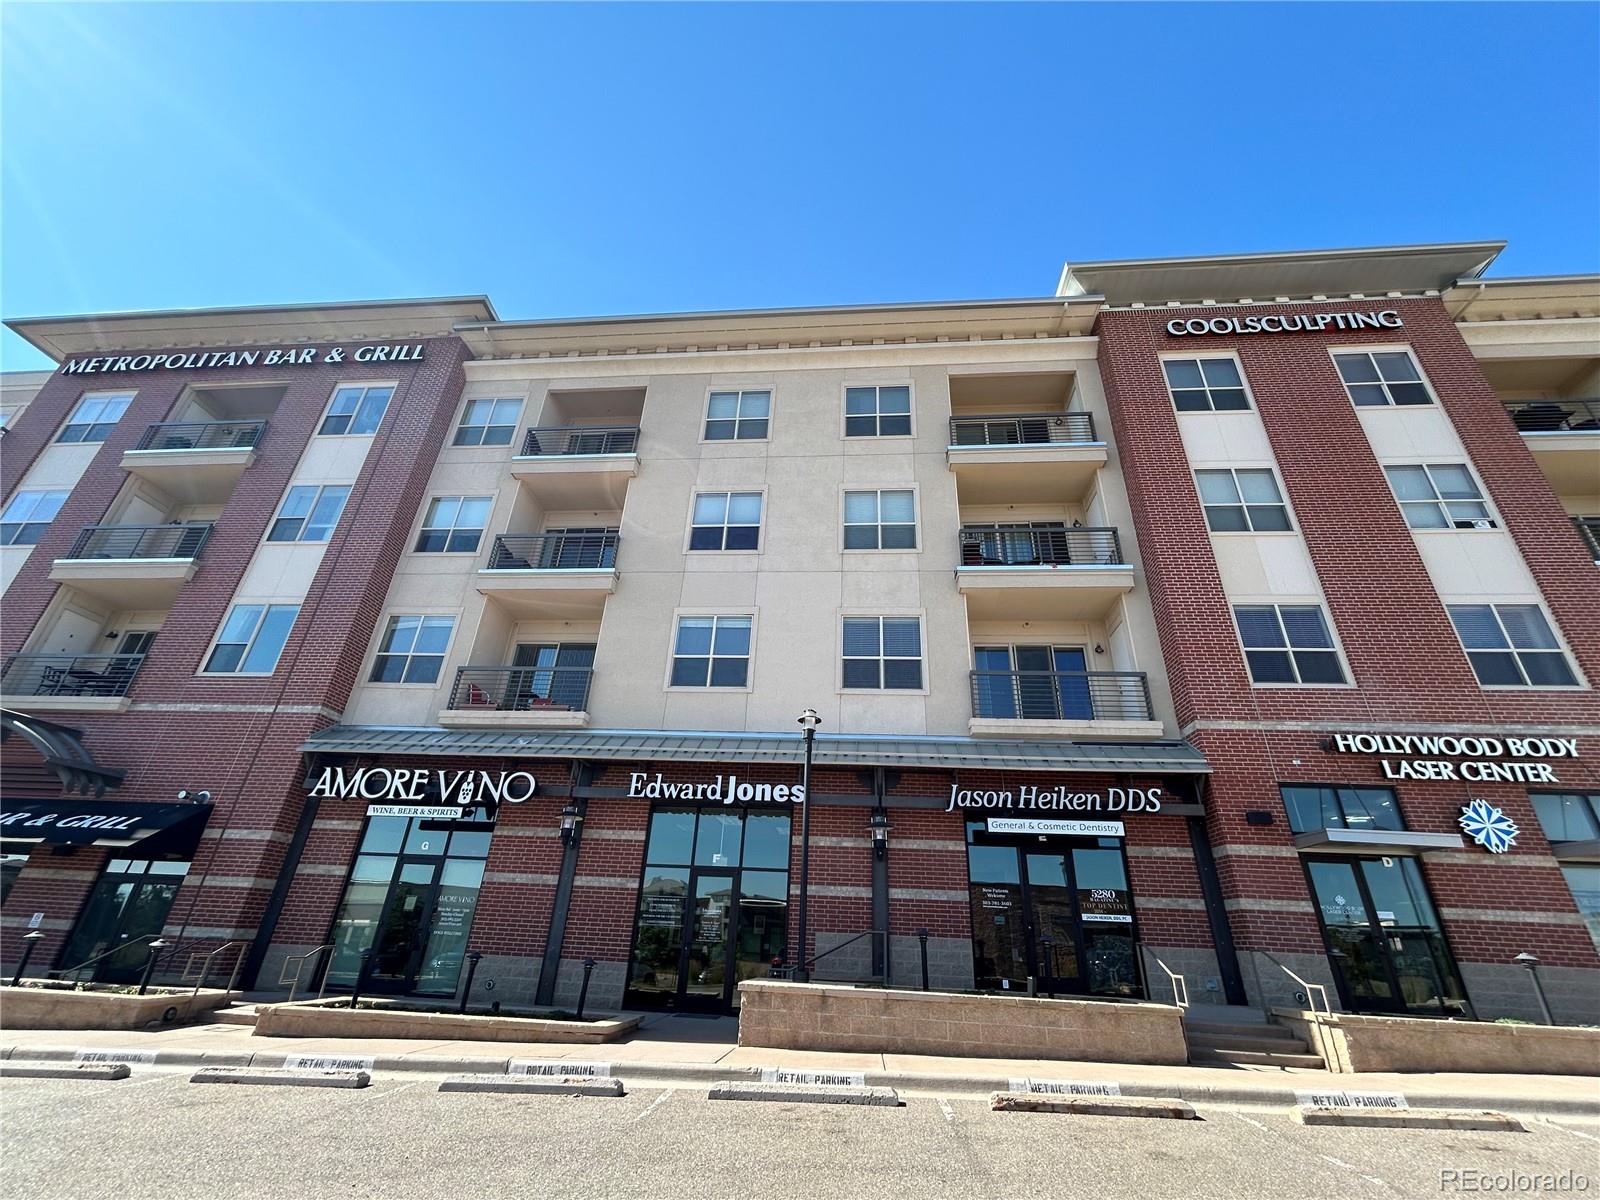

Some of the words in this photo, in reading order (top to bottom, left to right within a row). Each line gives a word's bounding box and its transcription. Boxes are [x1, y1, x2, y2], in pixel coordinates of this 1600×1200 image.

[1167, 310, 1404, 336] COOLSCULPTING
[61, 349, 263, 376] METROPOLITAN
[263, 347, 318, 366] BAR
[323, 347, 348, 363] &
[354, 344, 425, 362] GRILL
[1334, 733, 1504, 757] HOLLYWOOD
[1505, 737, 1580, 758] BODY
[1381, 759, 1460, 781] LASER
[1460, 761, 1560, 783] CENTER
[307, 766, 430, 800] AMORE
[626, 772, 722, 800] Edward
[723, 775, 806, 804] Jones
[945, 784, 1013, 813] Jason
[1018, 784, 1102, 811] Heiken
[1107, 788, 1162, 812] DDS
[372, 806, 396, 816] WINE,
[397, 807, 419, 815] BEER
[419, 807, 426, 815] &
[427, 808, 459, 817] SPIRITS
[23, 813, 59, 826] &
[56, 814, 143, 830] GRILL
[991, 820, 1026, 830] General
[1028, 821, 1035, 830] &
[1037, 822, 1077, 832] Cosmetic
[1080, 823, 1119, 834] Dentistry
[421, 841, 429, 851] G
[712, 854, 721, 863] F
[1381, 856, 1393, 867] D
[1091, 889, 1116, 899] 5280
[297, 1058, 325, 1069] RETAIL
[330, 1059, 364, 1069] PARKING
[560, 1065, 594, 1076] PARKING
[778, 1073, 809, 1084] RETAIL
[814, 1074, 851, 1085] PARKING
[1070, 1084, 1110, 1096] PARKING
[1312, 1095, 1350, 1107] RETAIL
[1354, 1096, 1397, 1107] PARKING
